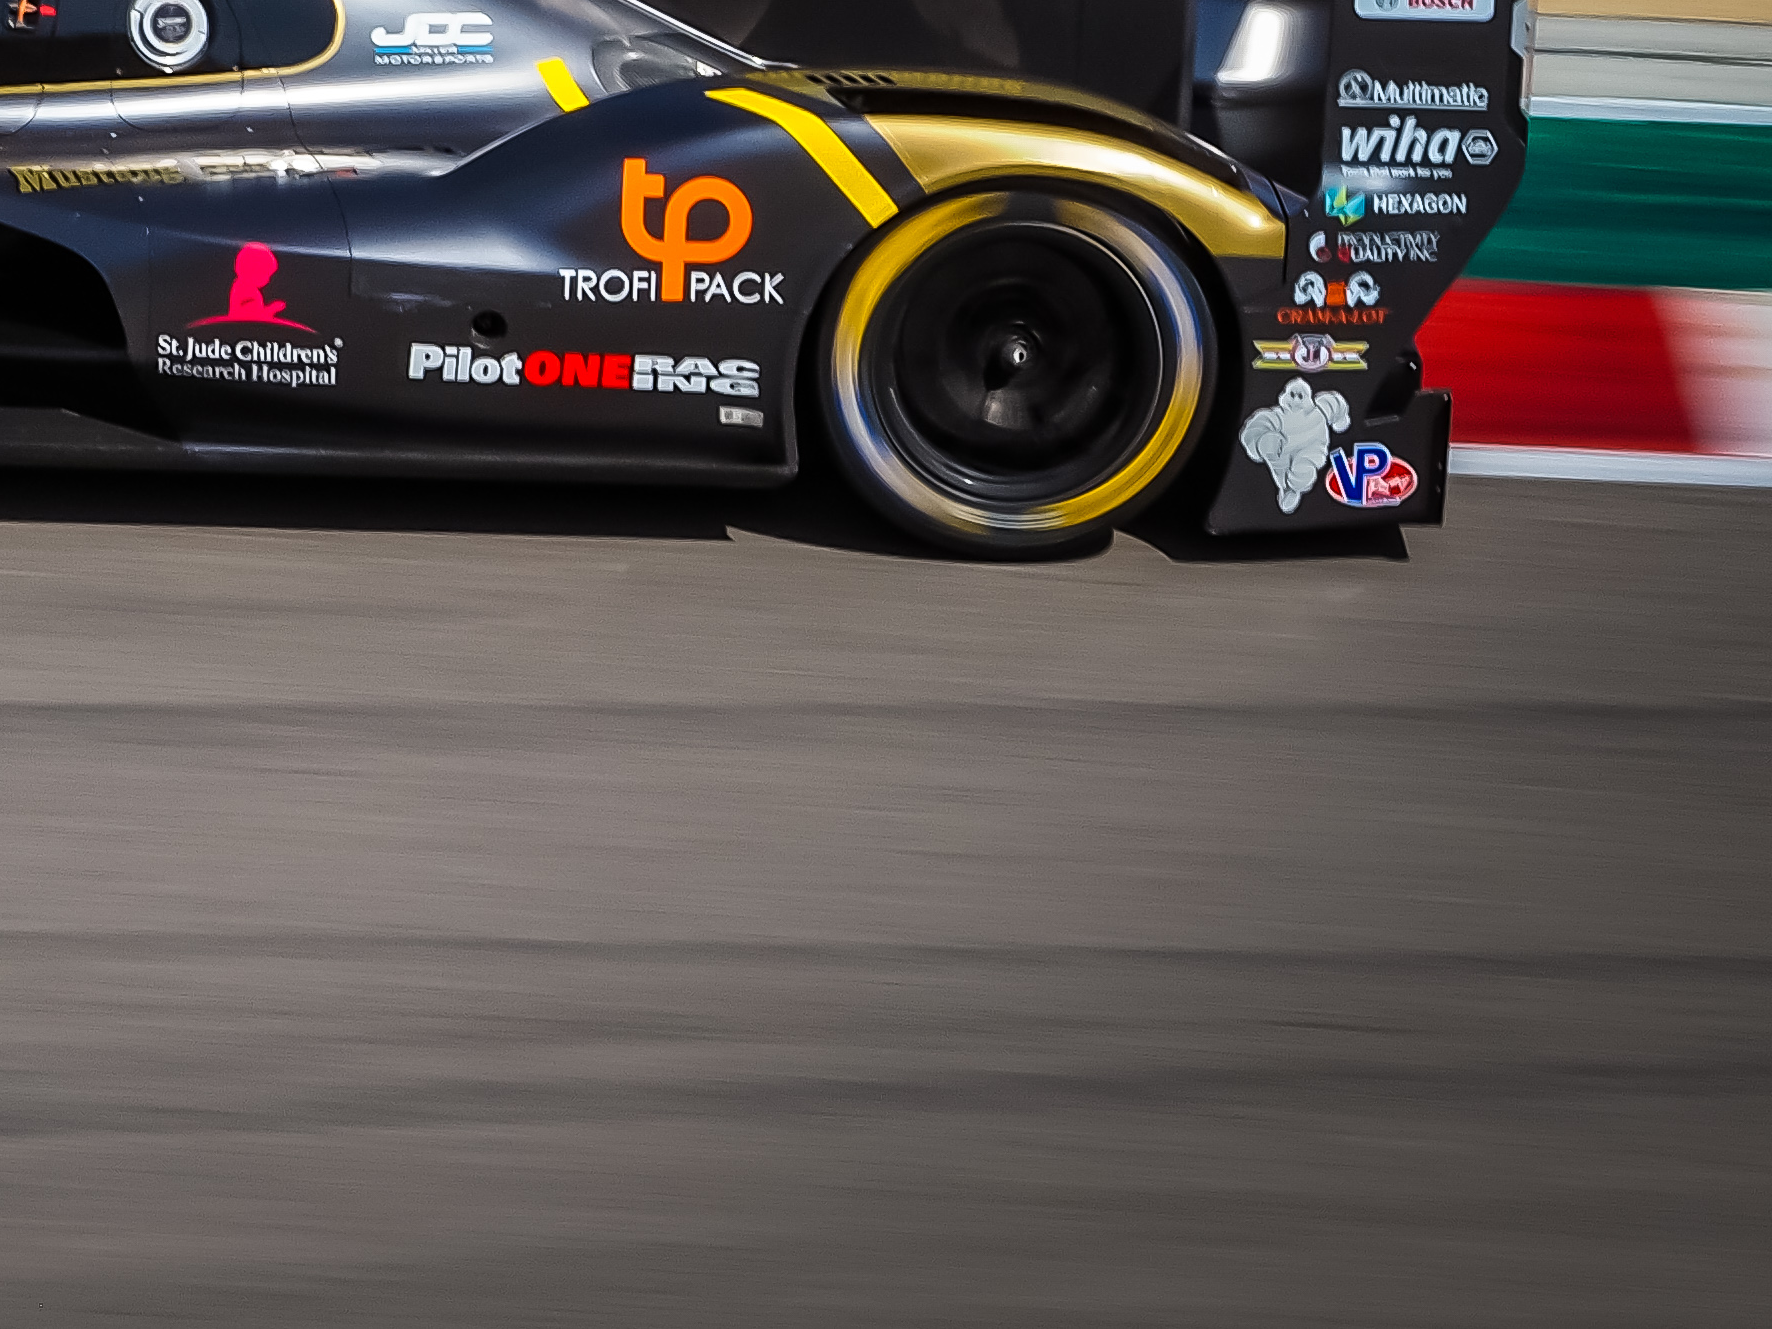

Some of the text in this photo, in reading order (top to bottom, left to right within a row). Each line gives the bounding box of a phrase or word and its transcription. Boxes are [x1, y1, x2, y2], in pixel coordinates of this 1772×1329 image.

[1373, 80, 1488, 105] Multimatic
[1341, 114, 1462, 164] wiha
[1373, 192, 1467, 215] HEXAGON
[559, 269, 784, 304] TROFI PACK
[157, 334, 184, 358] St.
[186, 337, 231, 361] Jude
[157, 358, 337, 387] Research Hospital
[1330, 443, 1392, 505] VP
